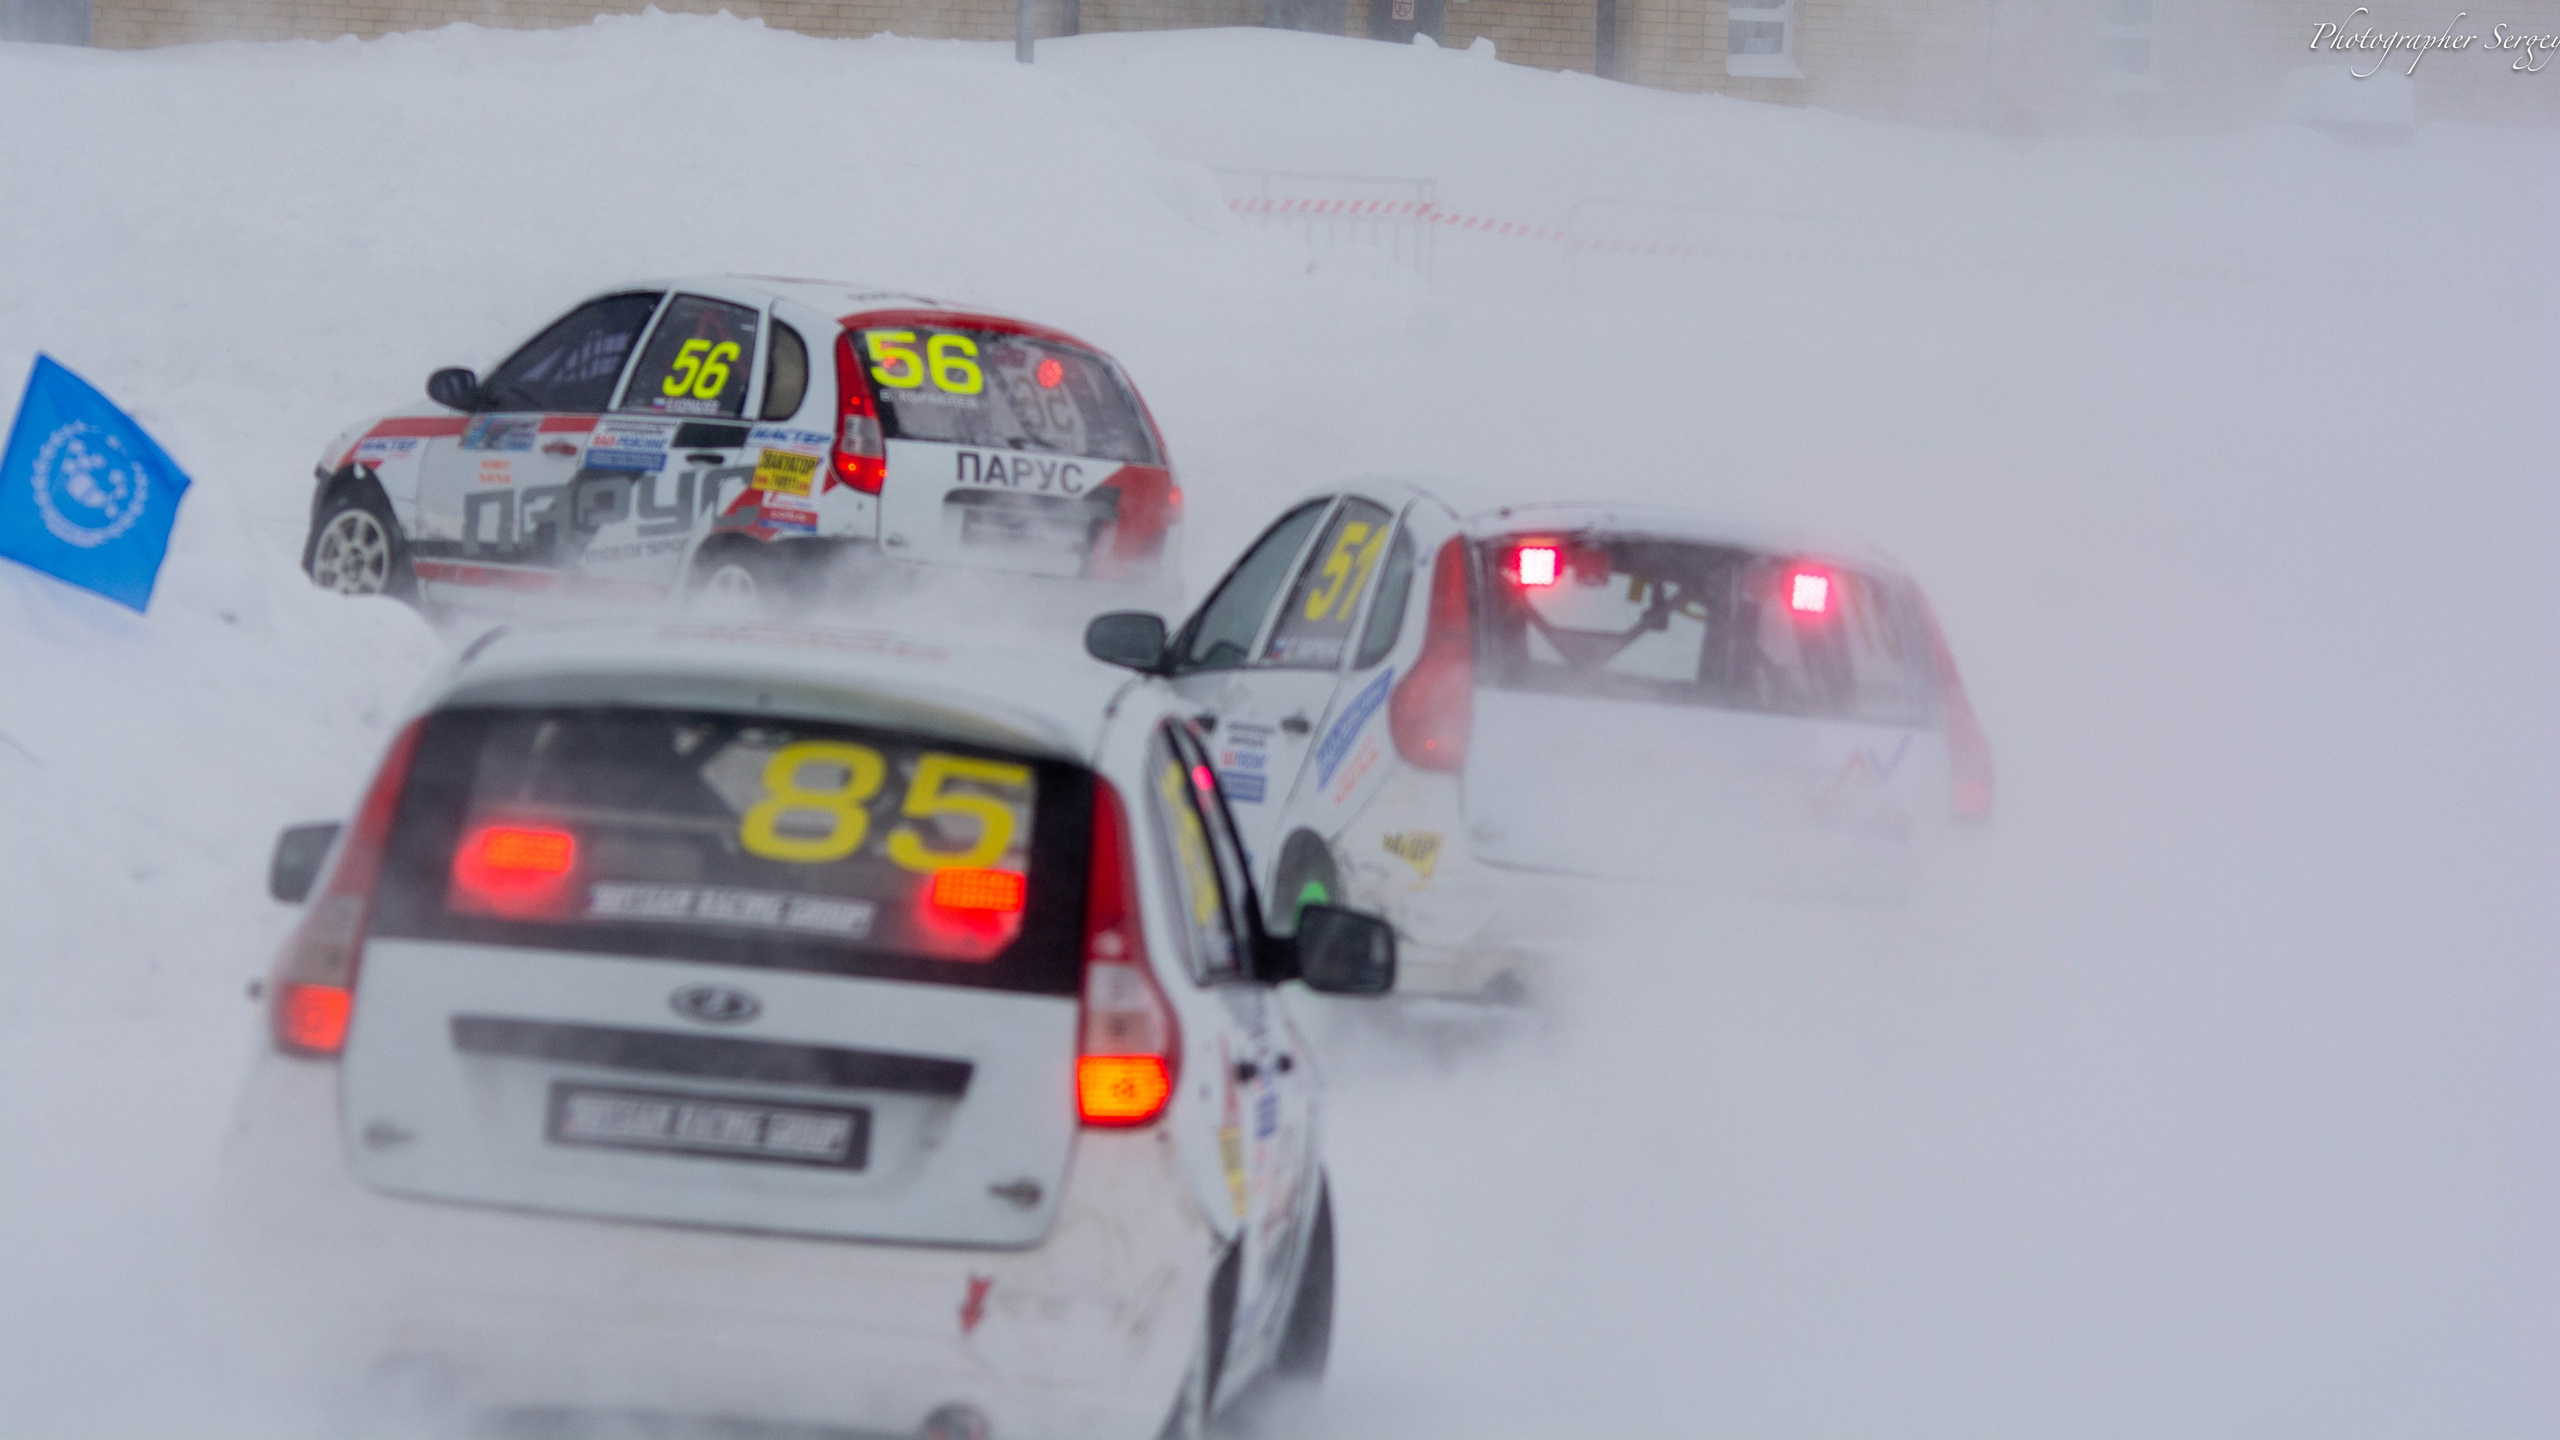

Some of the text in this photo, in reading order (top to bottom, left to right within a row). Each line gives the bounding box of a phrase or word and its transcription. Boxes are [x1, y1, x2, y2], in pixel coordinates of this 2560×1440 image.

[662, 339, 741, 400] 56
[865, 330, 983, 396] 56
[957, 451, 1083, 495] ПАРУС
[1305, 520, 1388, 623] 51
[739, 740, 1033, 870] 85
